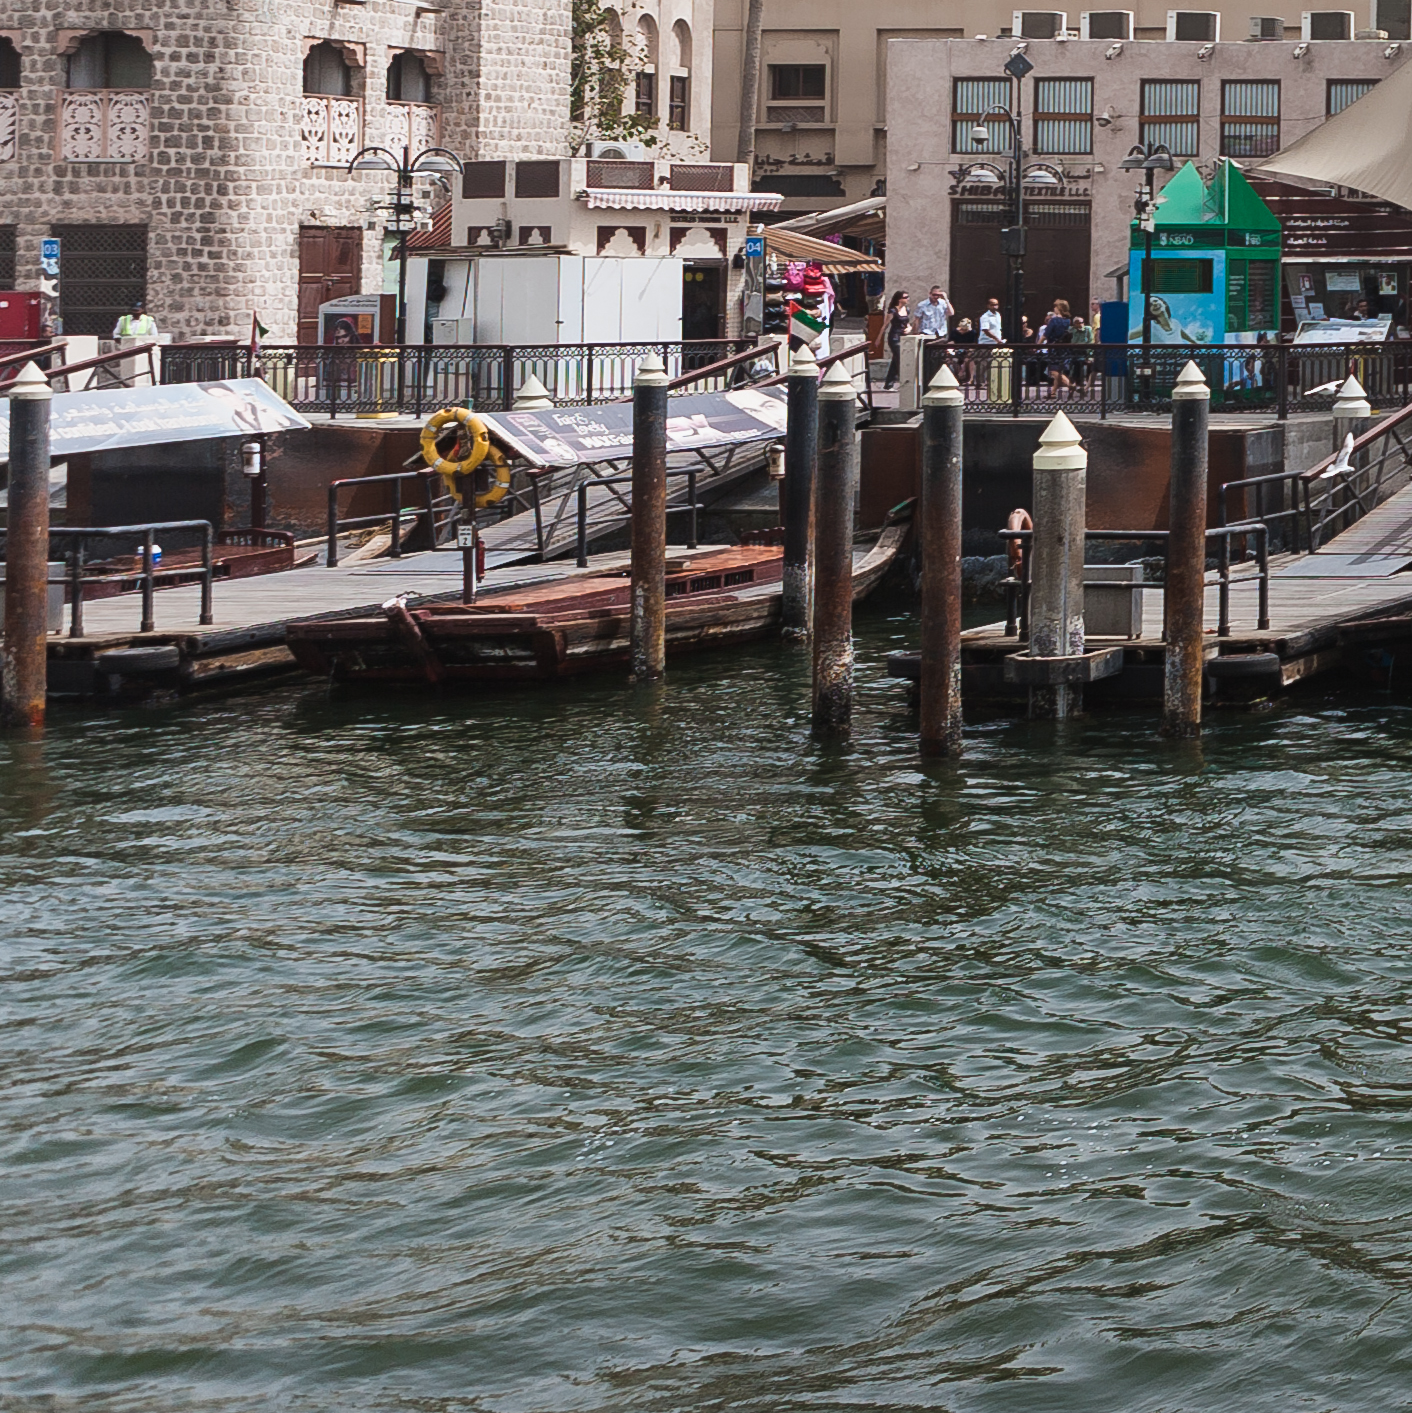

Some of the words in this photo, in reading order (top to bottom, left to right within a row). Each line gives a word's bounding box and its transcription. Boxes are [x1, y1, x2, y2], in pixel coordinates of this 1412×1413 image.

[1023, 186, 1066, 196] TEXTILE
[44, 244, 58, 254] 03
[747, 242, 761, 252] 04
